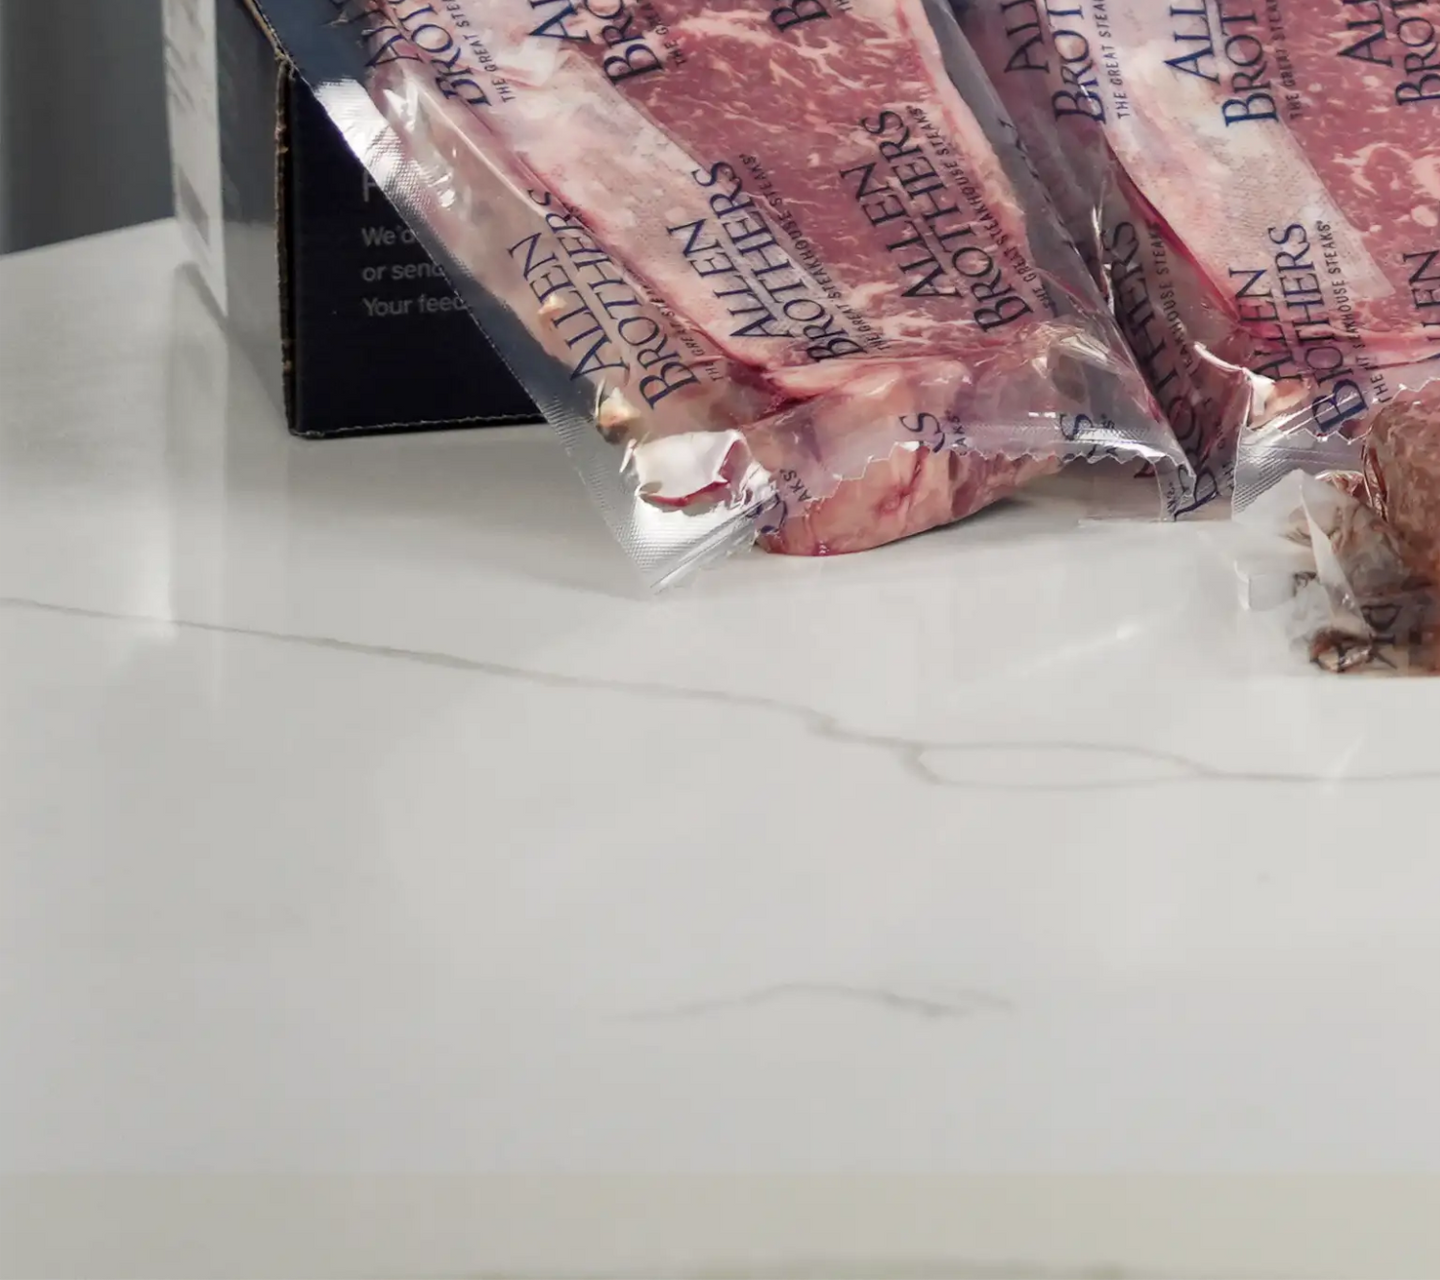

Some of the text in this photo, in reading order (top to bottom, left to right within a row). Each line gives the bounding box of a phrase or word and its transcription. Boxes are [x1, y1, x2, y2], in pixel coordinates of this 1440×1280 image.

[1101, 42, 1124, 87] GREAT
[1110, 94, 1131, 121] THE
[360, 266, 387, 282] or
[666, 219, 795, 339] ALLEN
[691, 161, 867, 363] BROTHERS
[839, 162, 963, 299] ALLEN
[859, 110, 1033, 332] BROTHERS
[363, 296, 413, 318] Your
[507, 232, 629, 382] ALLEN
[527, 189, 701, 409] BROTHERS
[1229, 267, 1302, 381] ALLEN
